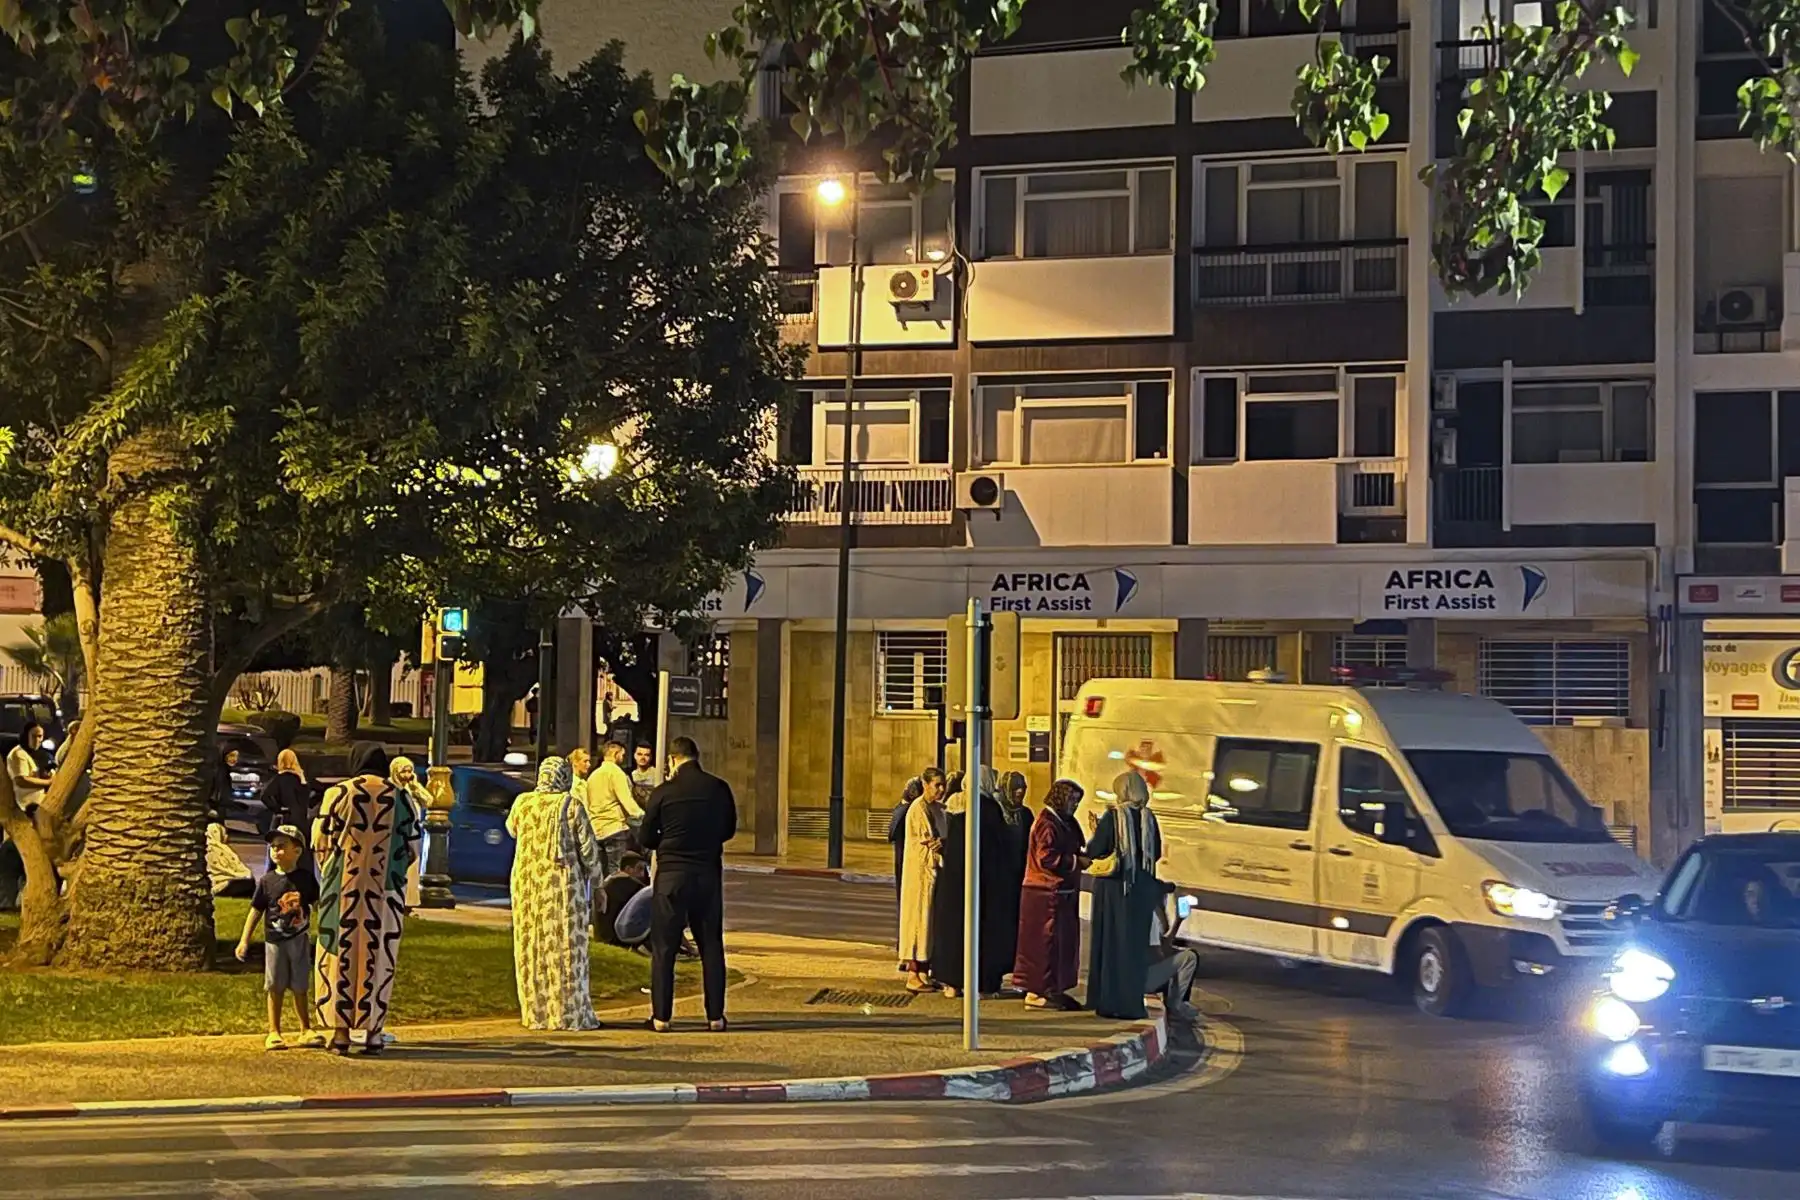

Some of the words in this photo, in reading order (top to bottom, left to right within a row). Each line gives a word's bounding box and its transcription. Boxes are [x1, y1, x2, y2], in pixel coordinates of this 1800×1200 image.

[991, 573, 1091, 591] AFRICA
[1385, 570, 1494, 589] AFRICA
[702, 597, 722, 611] ist
[990, 596, 1032, 611] First
[1036, 595, 1092, 611] Assist
[1384, 594, 1430, 610] First
[1435, 593, 1497, 610] Assist
[1725, 642, 1737, 653] de
[1704, 659, 1767, 677] Voyages
